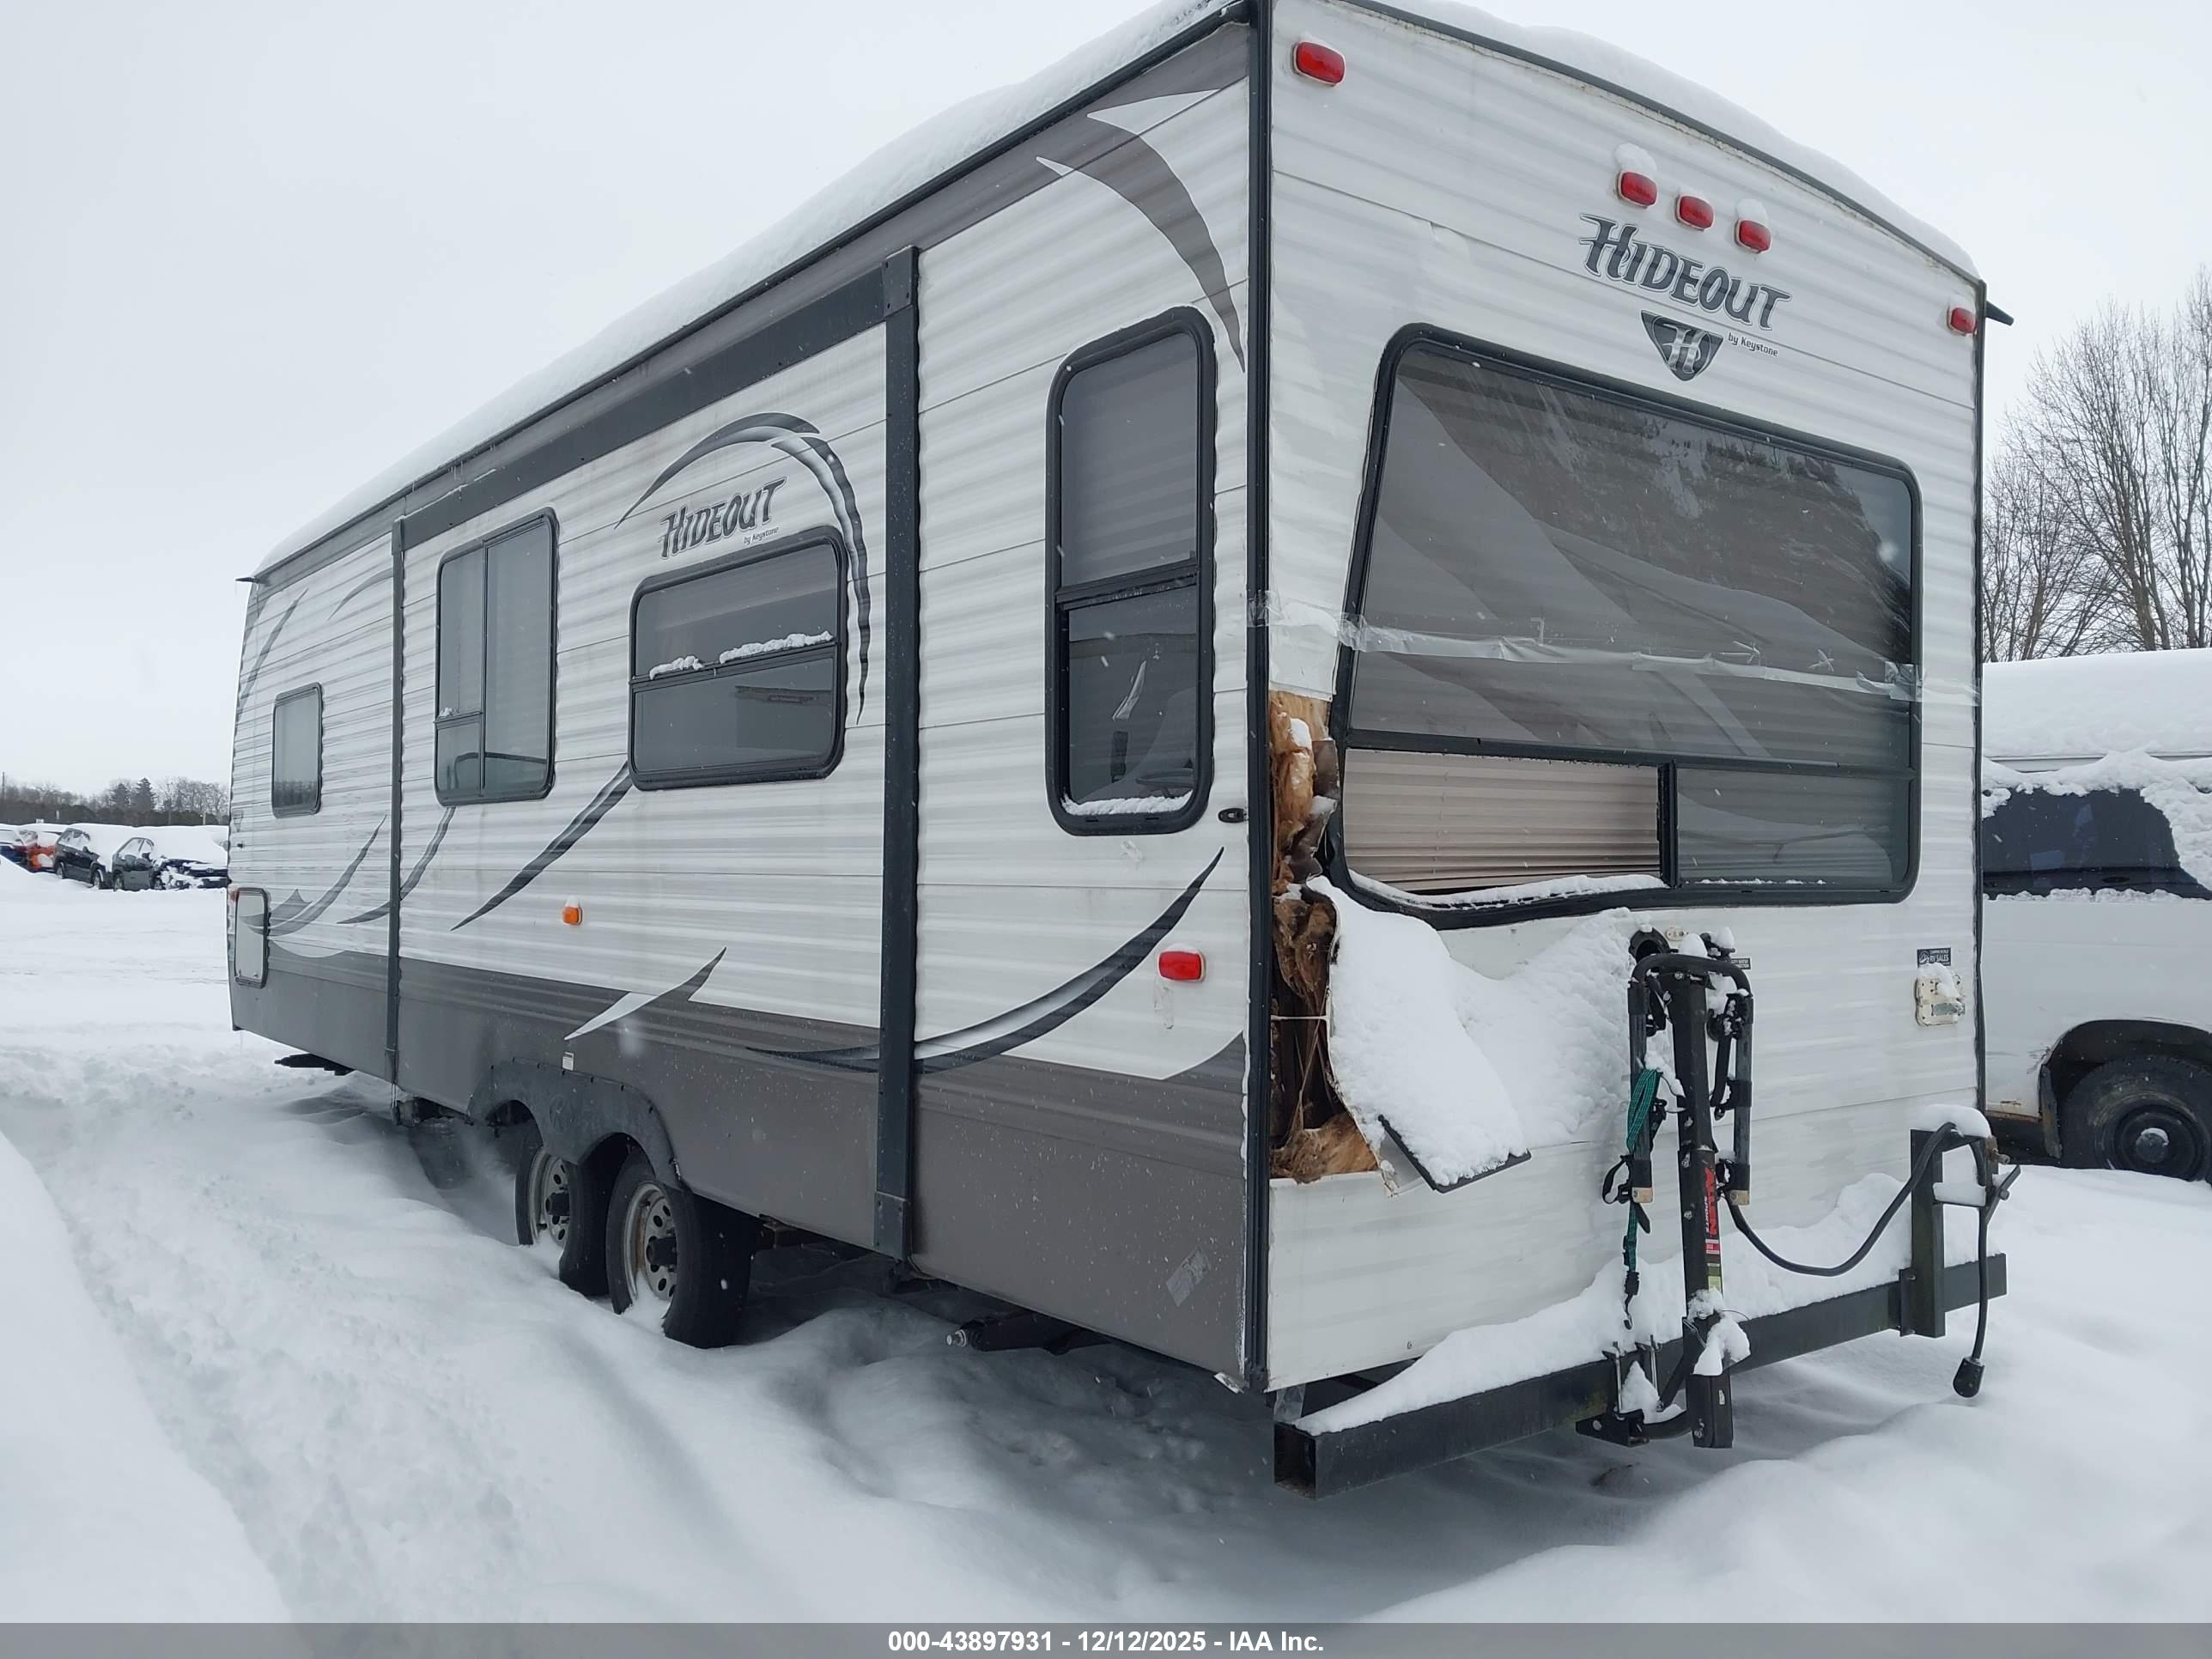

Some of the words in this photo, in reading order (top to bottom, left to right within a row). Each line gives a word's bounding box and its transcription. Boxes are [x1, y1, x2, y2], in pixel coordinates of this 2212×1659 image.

[1579, 213, 1792, 331] HIDEOUT
[1728, 332, 1739, 345] by
[1741, 336, 1778, 357] Keystone
[659, 477, 787, 559] HIDEOUT
